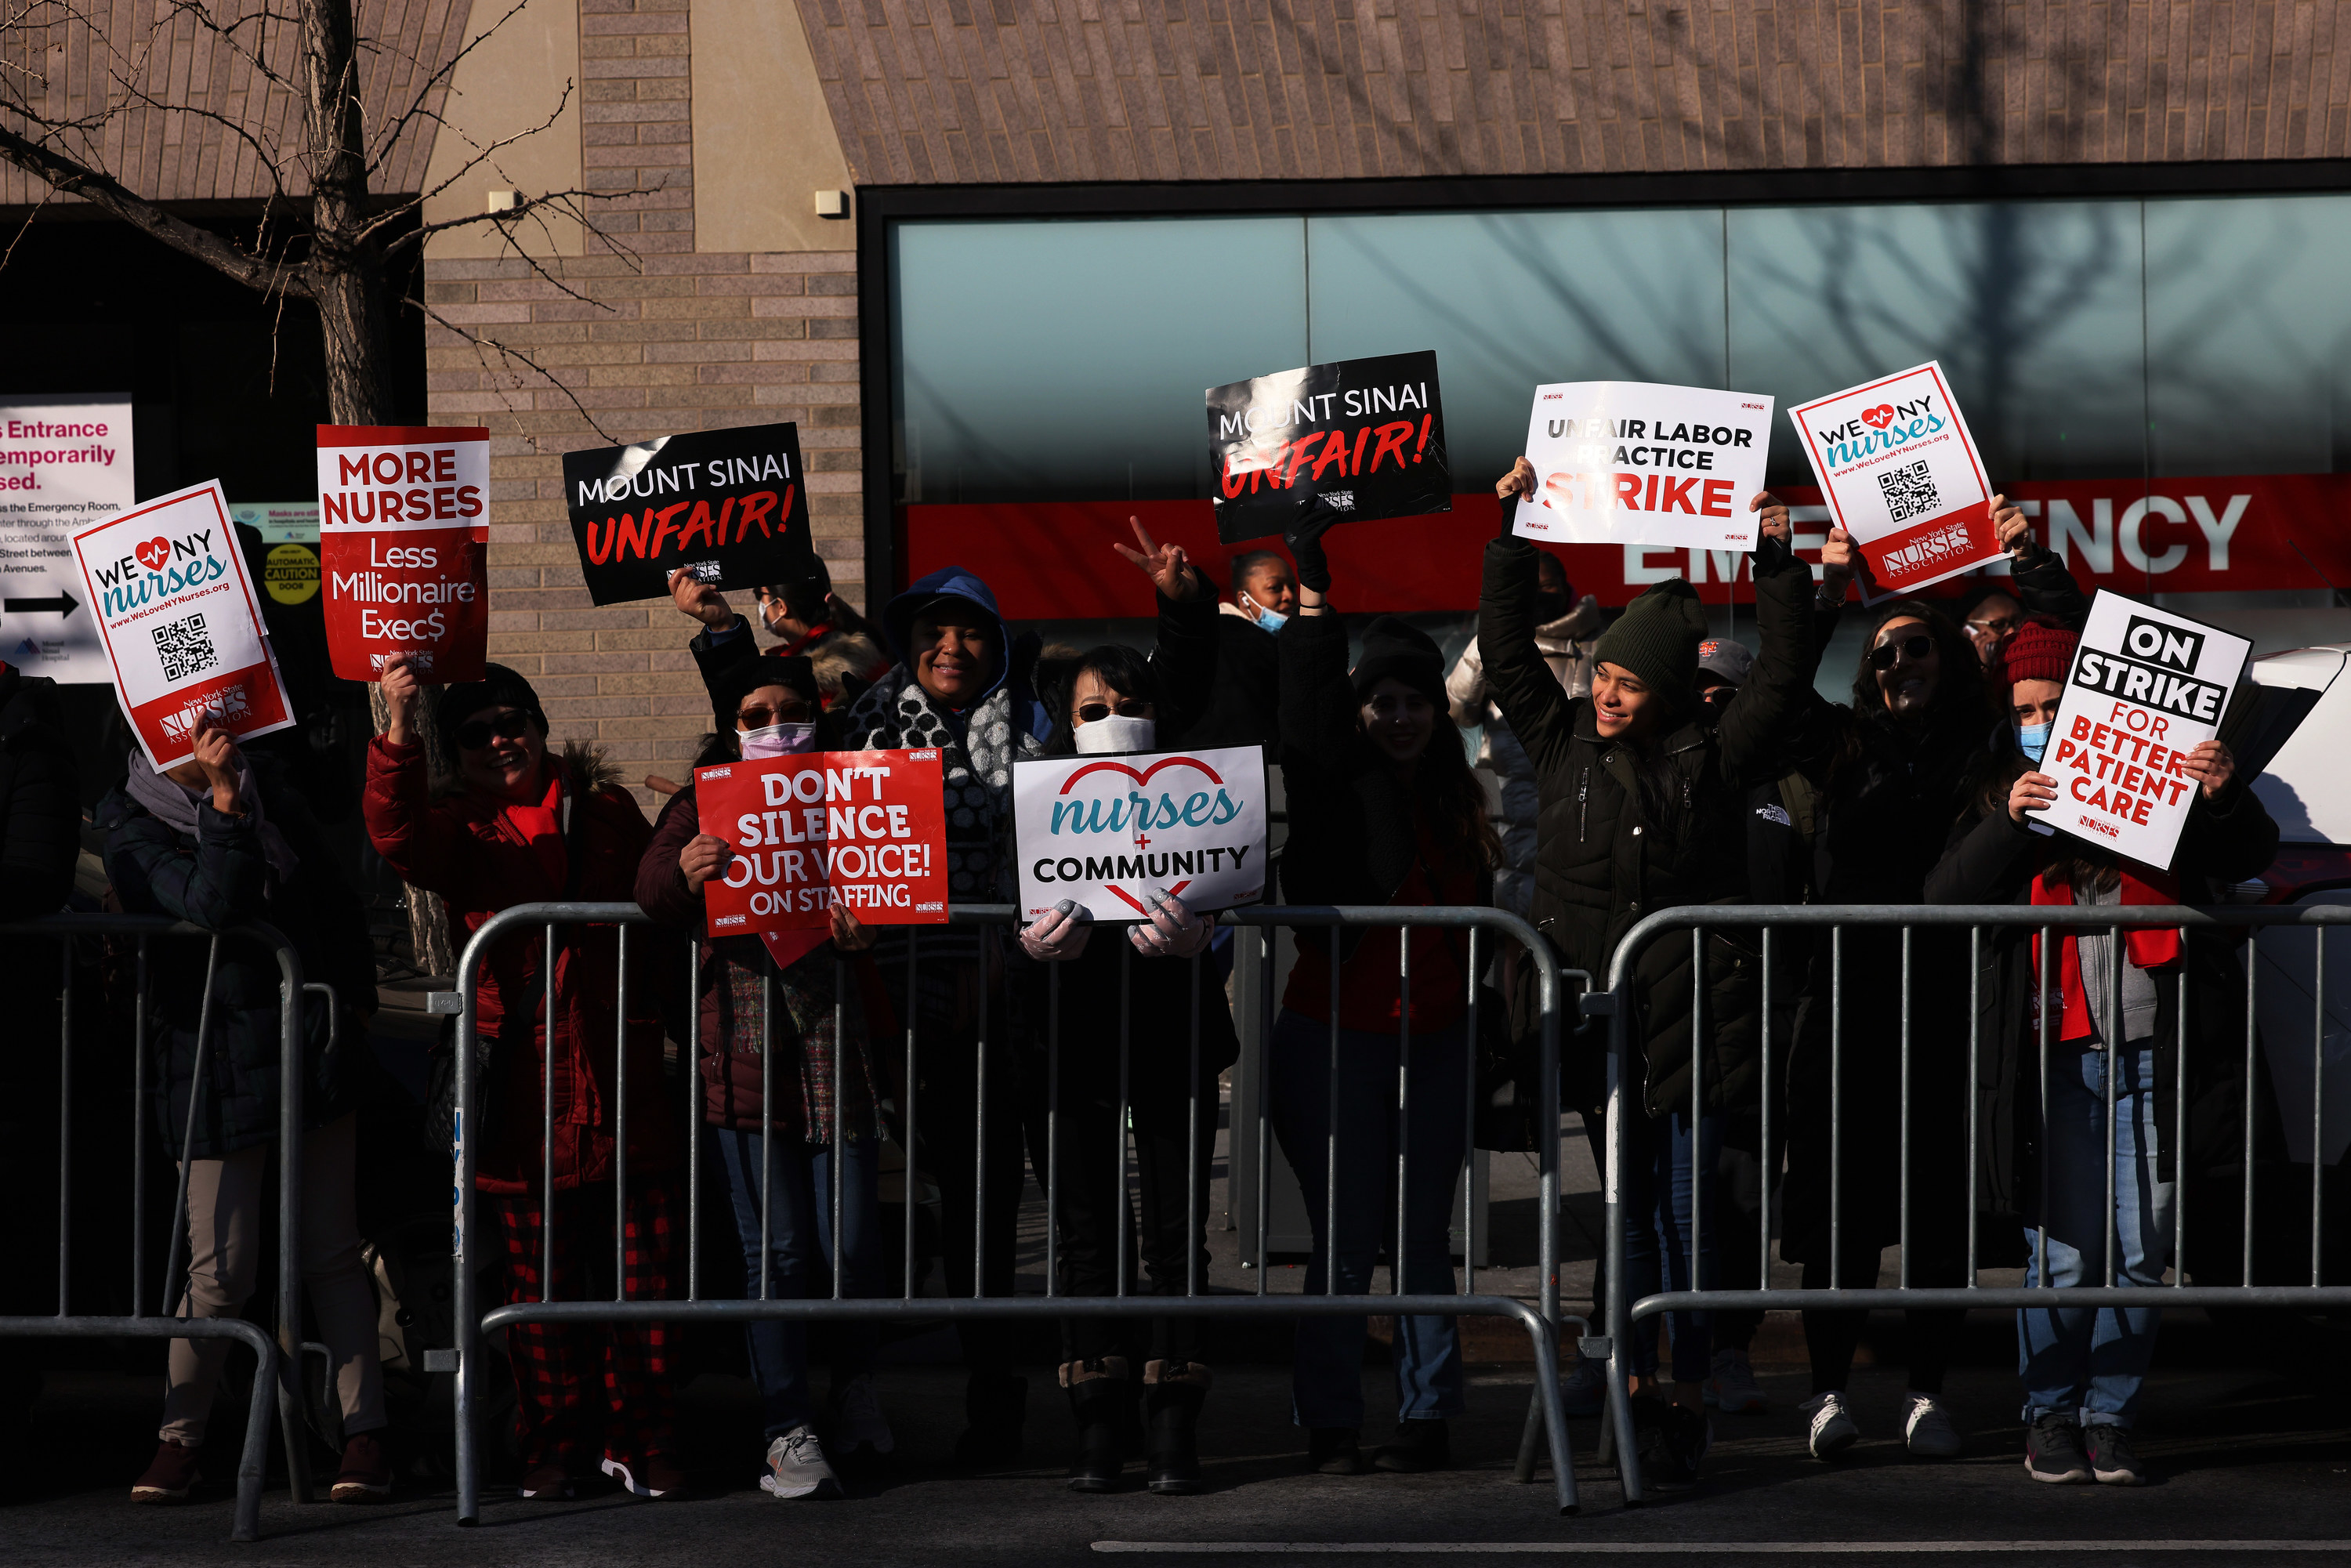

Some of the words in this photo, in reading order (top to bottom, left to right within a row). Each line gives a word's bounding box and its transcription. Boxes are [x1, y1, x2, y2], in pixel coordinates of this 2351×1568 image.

[8, 421, 108, 439] Entrance
[1220, 393, 1336, 440] MOUNT
[1344, 382, 1428, 417] SINAI
[1819, 419, 1864, 445] WE
[1896, 395, 1930, 421] NY
[1549, 419, 1646, 440] UNFAIR
[1654, 421, 1753, 448] LABOR
[1828, 413, 1946, 467] nurses
[0, 445, 115, 468] emporarily
[339, 449, 457, 486] MORE
[1221, 413, 1432, 498] UNFAIR!
[1577, 444, 1714, 471] PRACTICE
[1833, 433, 1950, 477] www.WeLoveNYNurses.org
[578, 462, 701, 506] MOUNT
[708, 452, 791, 487] SINAI
[1542, 472, 1735, 518] STRIKE
[10, 503, 26, 512] the
[28, 502, 85, 513] Emergency
[88, 502, 121, 511] Room,
[17, 518, 53, 529] through
[55, 517, 70, 527] the
[323, 485, 484, 525] NURSES
[587, 483, 795, 566] UNFAIR!
[5, 533, 39, 543] located
[1882, 527, 1969, 572] NURSES
[1909, 537, 1928, 545] New
[1928, 527, 1946, 538] York
[1947, 522, 1965, 533] State
[0, 549, 28, 558] Street
[31, 549, 73, 558] between
[3, 564, 47, 574] Avenues.
[95, 555, 139, 588] WE
[172, 528, 211, 561] NY
[371, 538, 437, 569] Less
[1889, 541, 1974, 579] ASSOCIATION
[103, 554, 227, 617] nurses
[264, 569, 317, 580] CAUTION
[332, 570, 475, 603] Millionaire
[110, 582, 230, 629] www.WeLoveNYNurses.org
[362, 608, 445, 643] Exec$
[2128, 625, 2194, 668] ON
[183, 697, 203, 709] New
[202, 690, 223, 701] York
[223, 684, 243, 696] State
[2078, 654, 2221, 721] STRIKE
[2110, 702, 2169, 741] FOR
[2070, 715, 2187, 779] BETTER
[701, 769, 731, 780] NURSES
[761, 766, 890, 806] DON'T
[2056, 738, 2189, 806] PATIENT
[1050, 788, 1244, 835] nurses
[2070, 777, 2154, 827] CARE
[737, 805, 911, 847] SILENCE
[2078, 814, 2120, 838] NURSES
[720, 849, 808, 888] OUR
[811, 844, 930, 879] VOICE!
[1033, 845, 1250, 883] COMMUNITY
[749, 889, 792, 916] ON
[799, 884, 911, 911] STAFFING
[715, 916, 746, 925] NURSES
